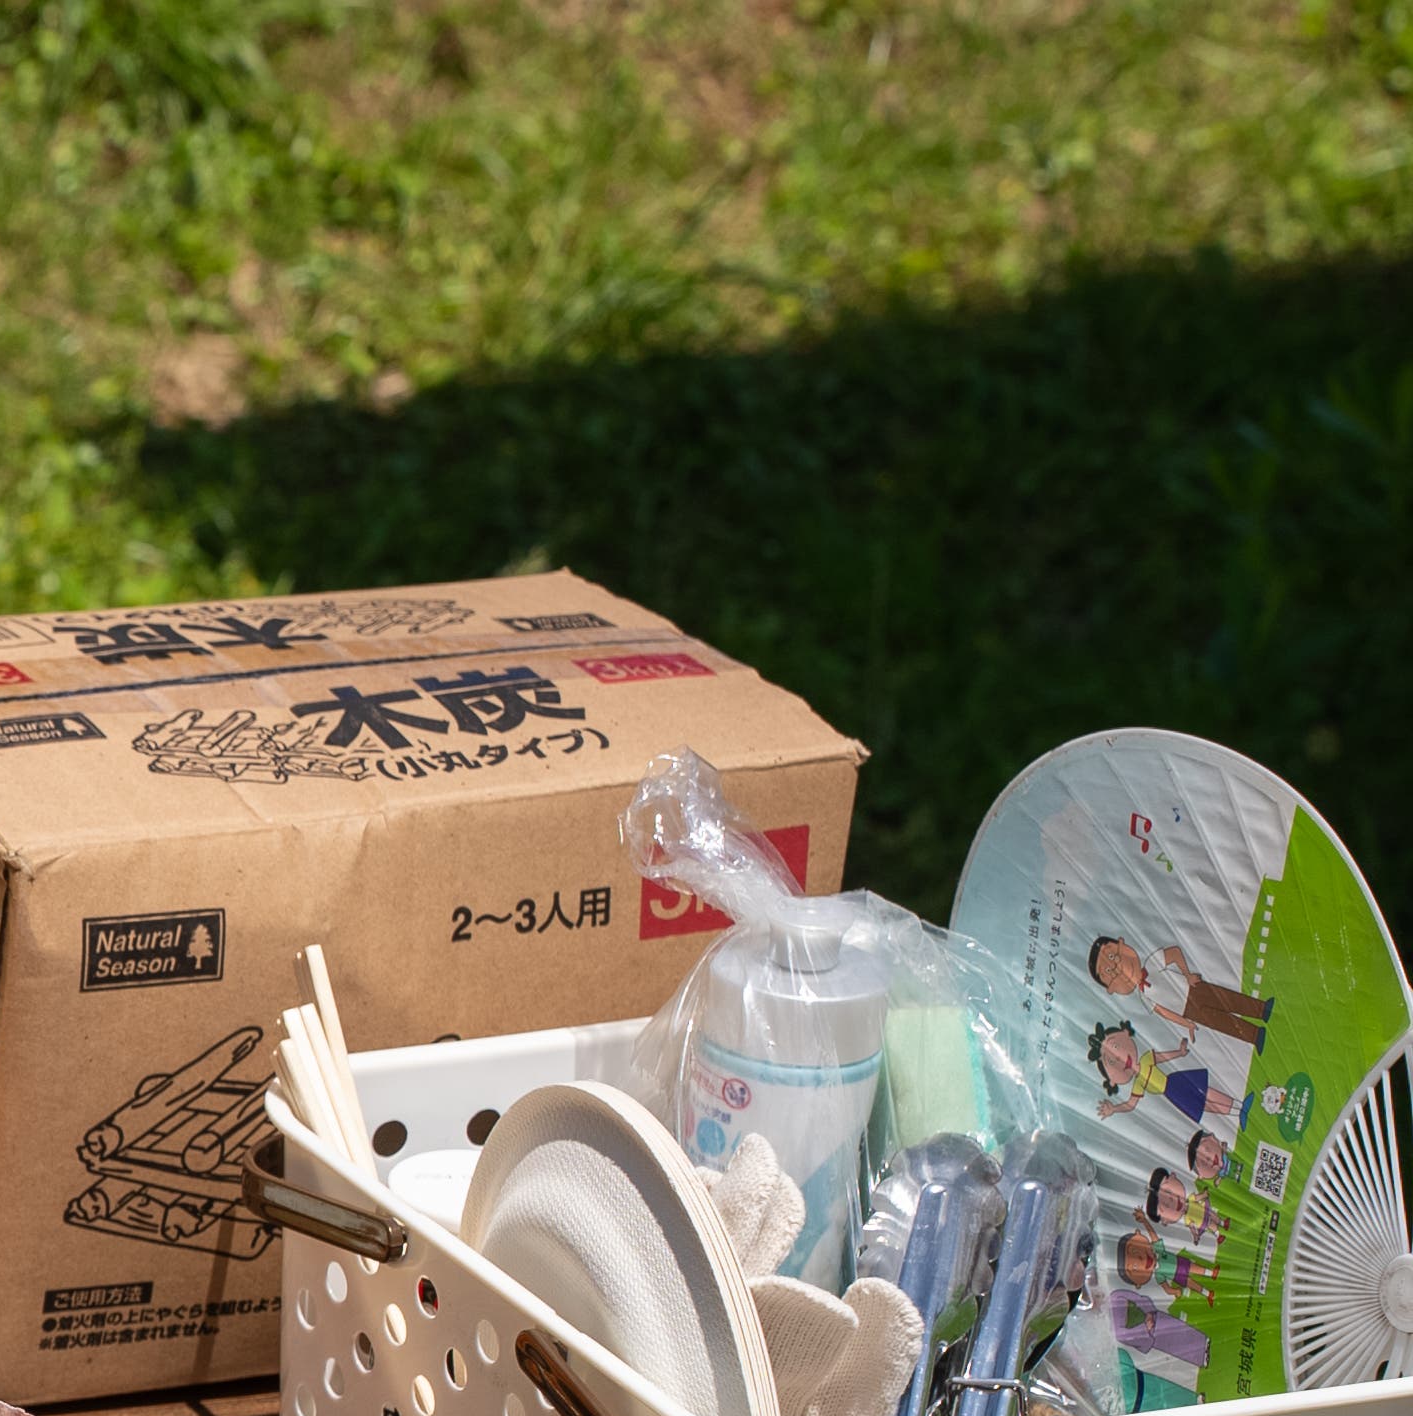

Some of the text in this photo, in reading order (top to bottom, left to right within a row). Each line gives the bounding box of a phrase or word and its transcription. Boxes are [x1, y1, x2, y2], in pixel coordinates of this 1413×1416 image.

[52, 616, 326, 665] 木炭
[289, 666, 586, 749] 木炭
[375, 727, 610, 781] （小丸タイプ）
[95, 923, 182, 954] Natural
[451, 886, 612, 943] 2～3人用
[95, 956, 177, 978] Season
[53, 1285, 144, 1310] ご使用方法
[1236, 1327, 1258, 1396] 宮城県
